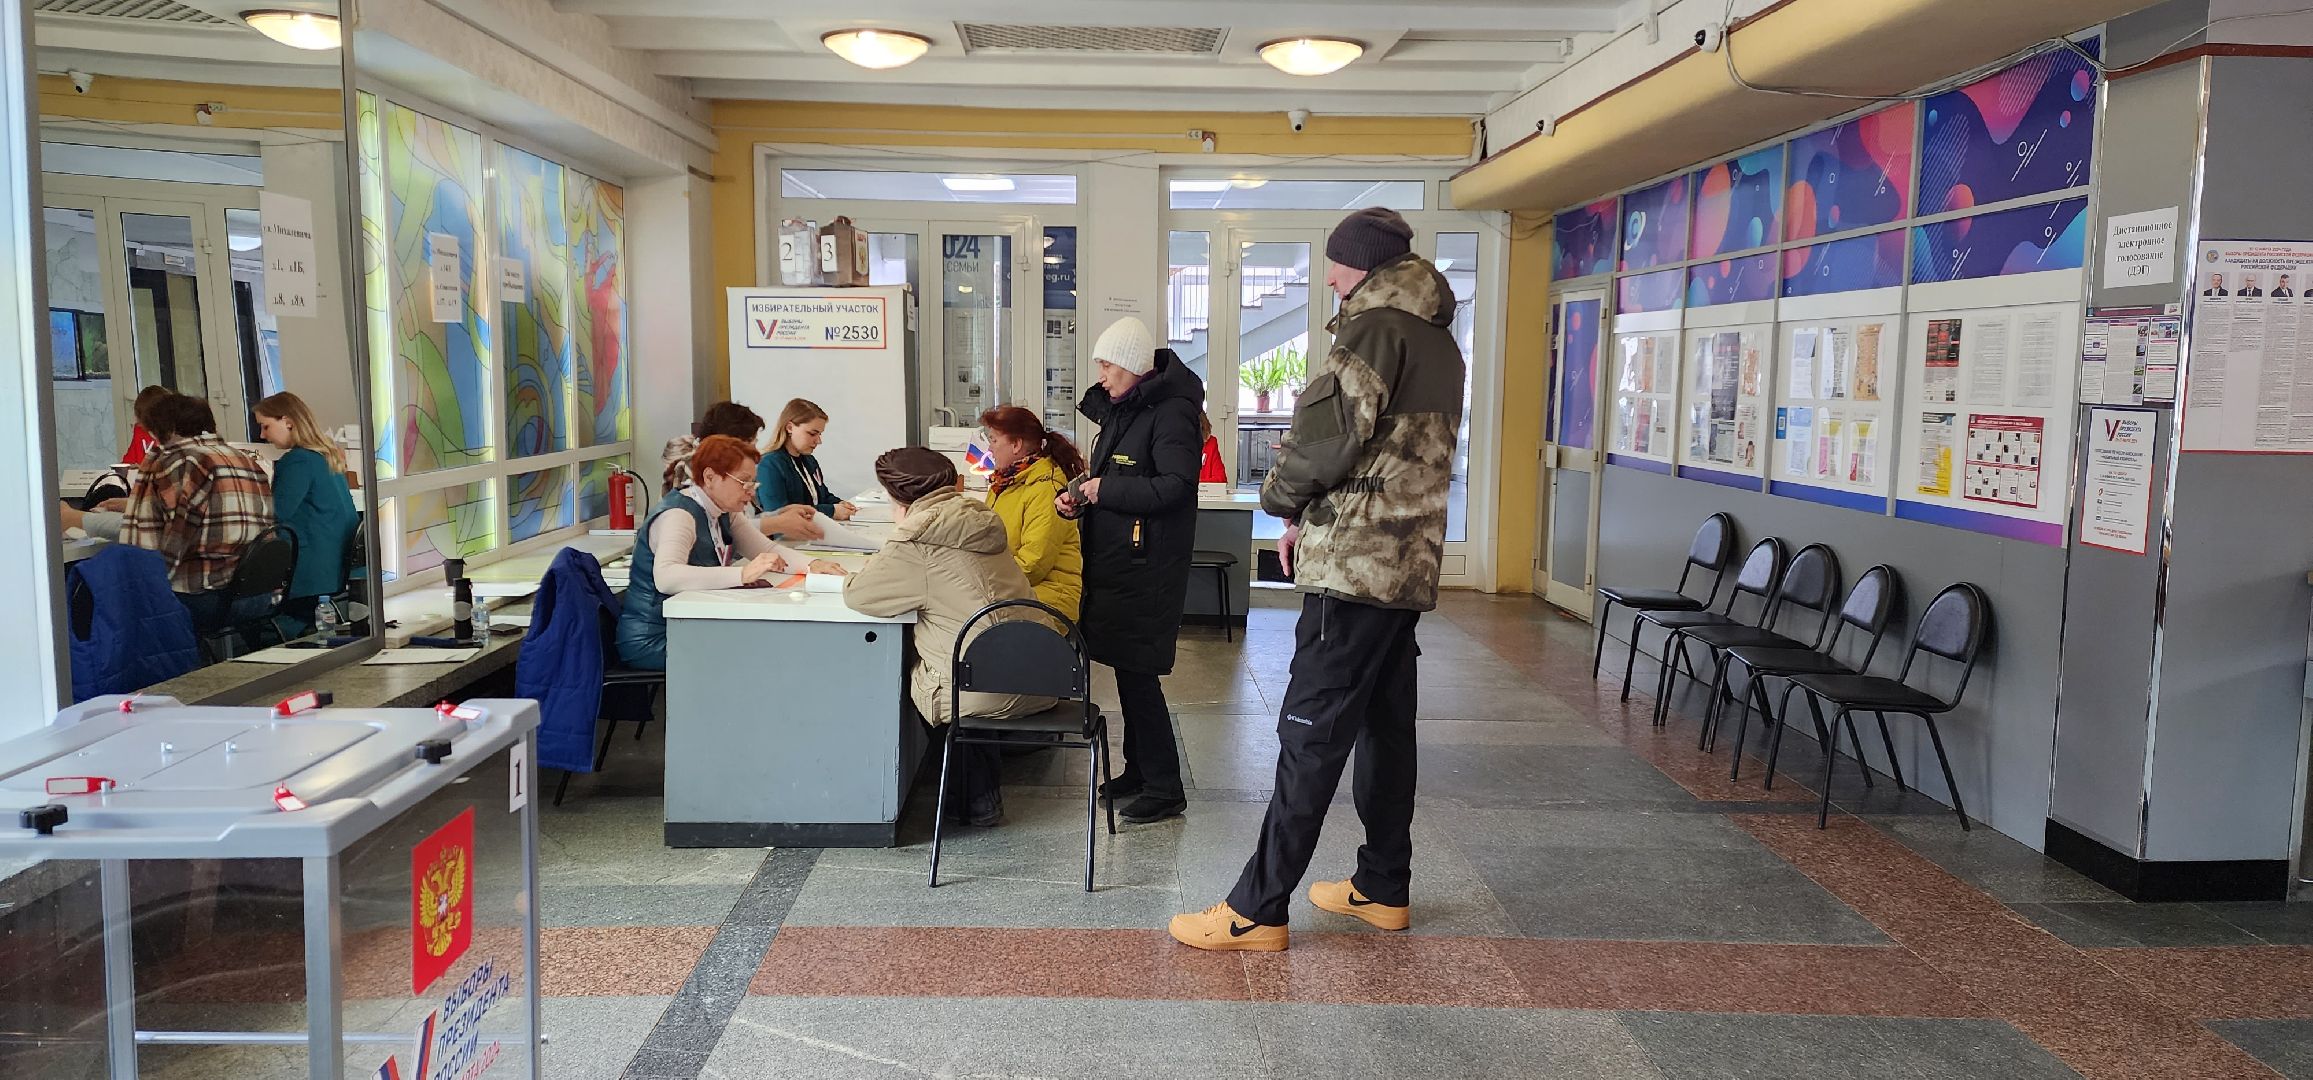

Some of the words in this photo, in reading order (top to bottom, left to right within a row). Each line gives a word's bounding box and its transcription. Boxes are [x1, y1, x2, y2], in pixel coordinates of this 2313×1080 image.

[2113, 222, 2173, 237] Дистанционное
[780, 242, 793, 261] 2
[823, 242, 833, 262] 3
[2118, 237, 2165, 249] электронное
[2117, 252, 2164, 262] голосование
[2127, 264, 2150, 277] (ДЭГ)
[752, 302, 833, 313] ИЗБИРАТЕЛЬНЫЙ
[836, 304, 879, 314] УЧАСТОК
[513, 758, 523, 799] 1
[442, 955, 494, 1024] ВЫБОРЫ
[436, 971, 510, 1063] ПРЕЗИДЕНТА
[433, 1030, 479, 1080] РОССИИ
